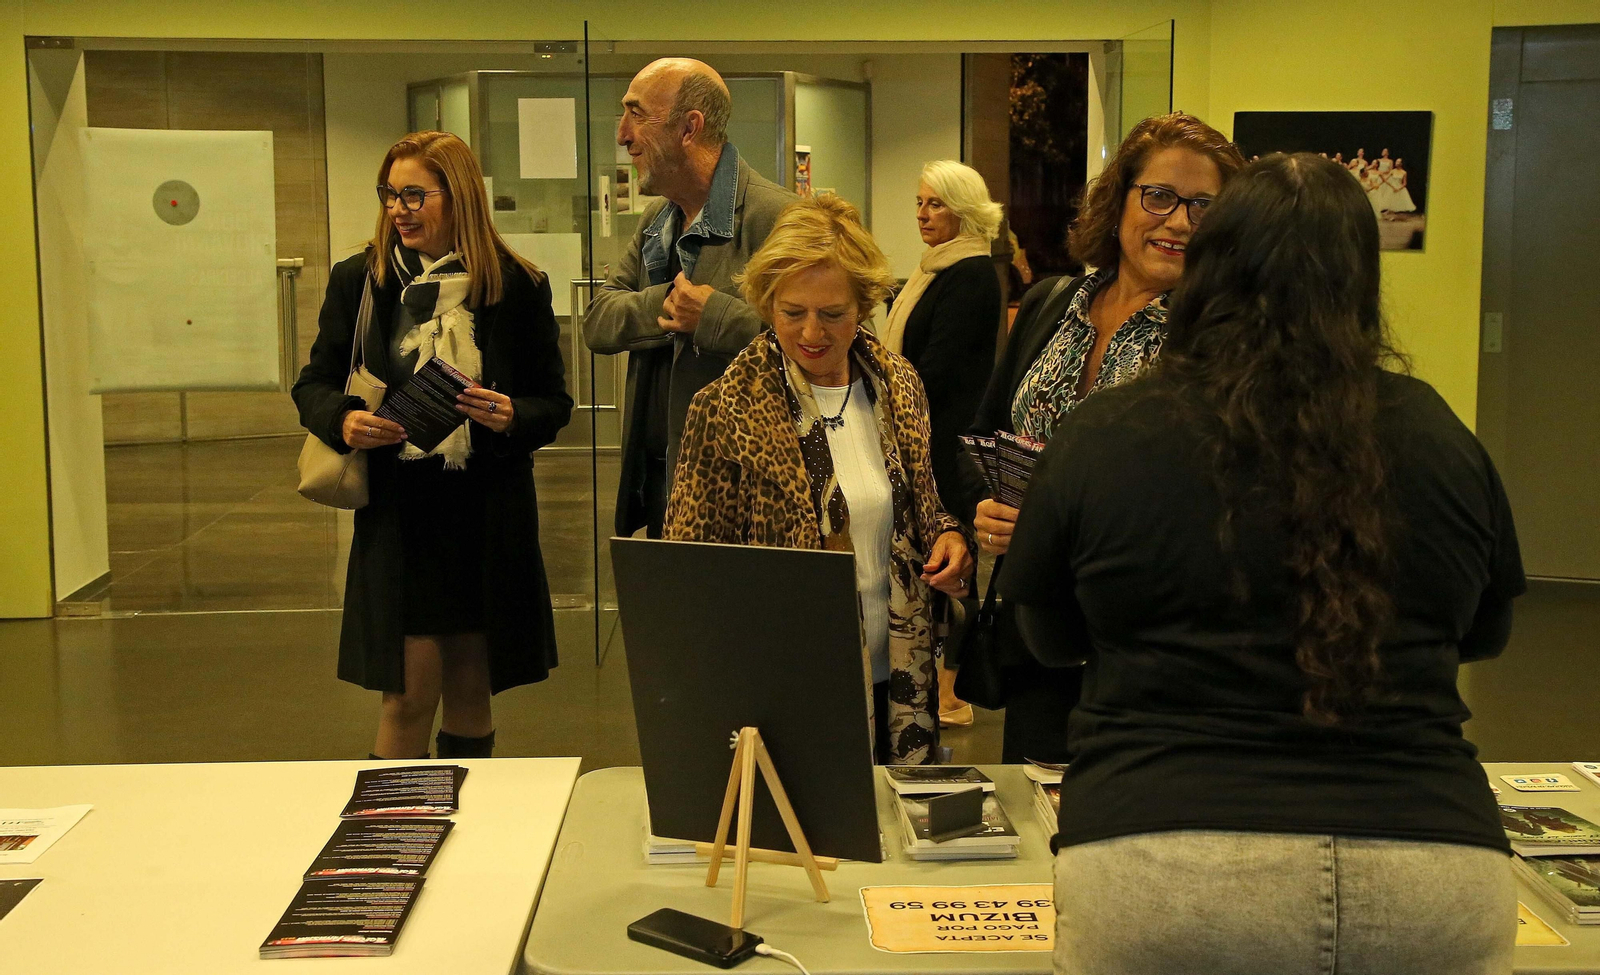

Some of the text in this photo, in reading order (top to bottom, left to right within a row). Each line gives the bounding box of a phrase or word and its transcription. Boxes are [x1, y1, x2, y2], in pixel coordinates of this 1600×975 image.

[889, 899, 1054, 910] 39 43 99 59
[930, 912, 1039, 922] BIZUM
